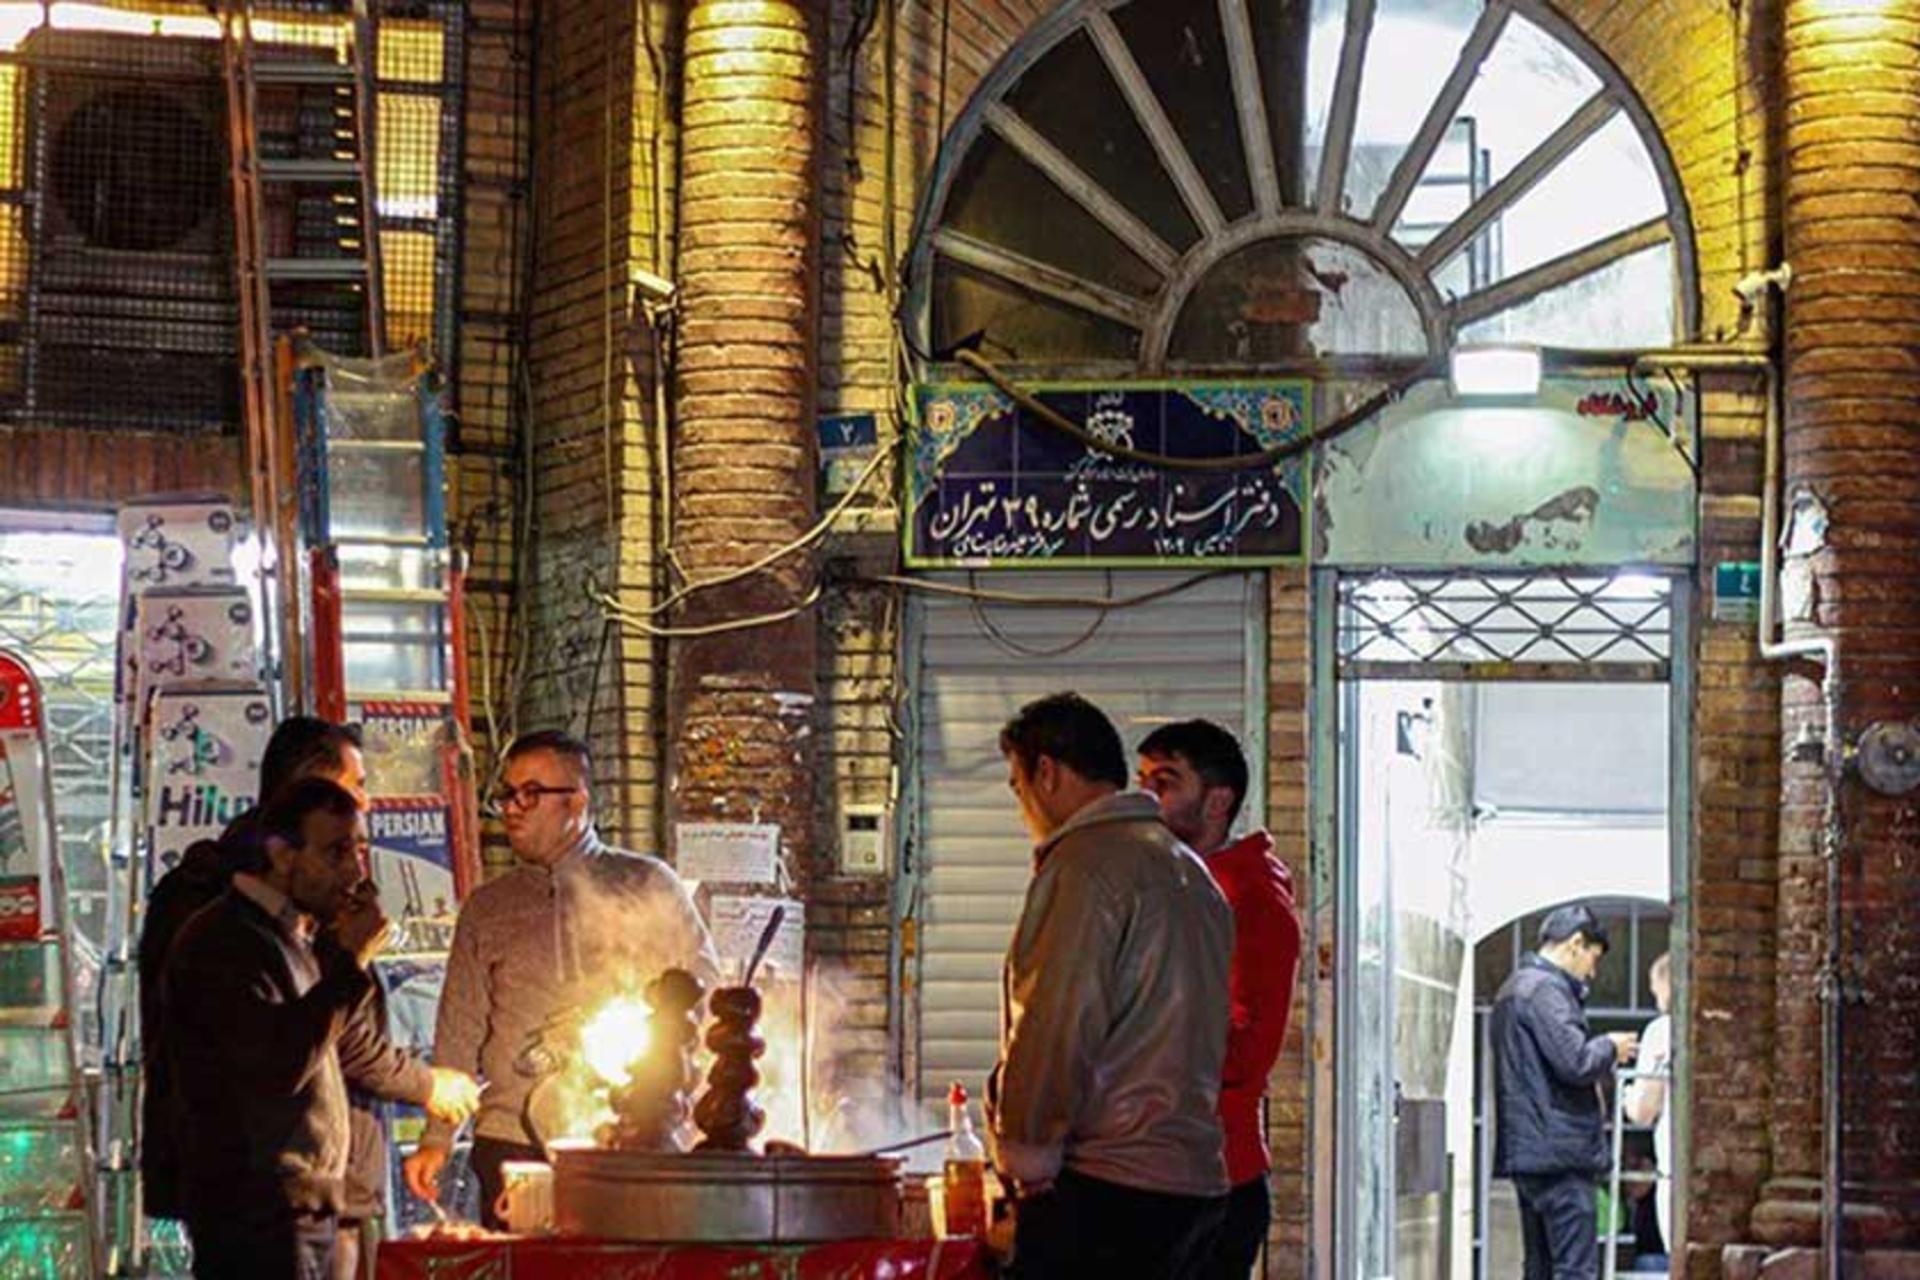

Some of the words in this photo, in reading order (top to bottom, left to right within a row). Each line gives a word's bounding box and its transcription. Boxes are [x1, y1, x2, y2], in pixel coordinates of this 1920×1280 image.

[929, 480, 998, 540] تهران
[1042, 482, 1092, 532] شماره
[1089, 490, 1142, 540] رسمی
[1146, 484, 1238, 531] اسناد
[1232, 479, 1279, 534] دفتر
[371, 810, 446, 838] PERSIAN
